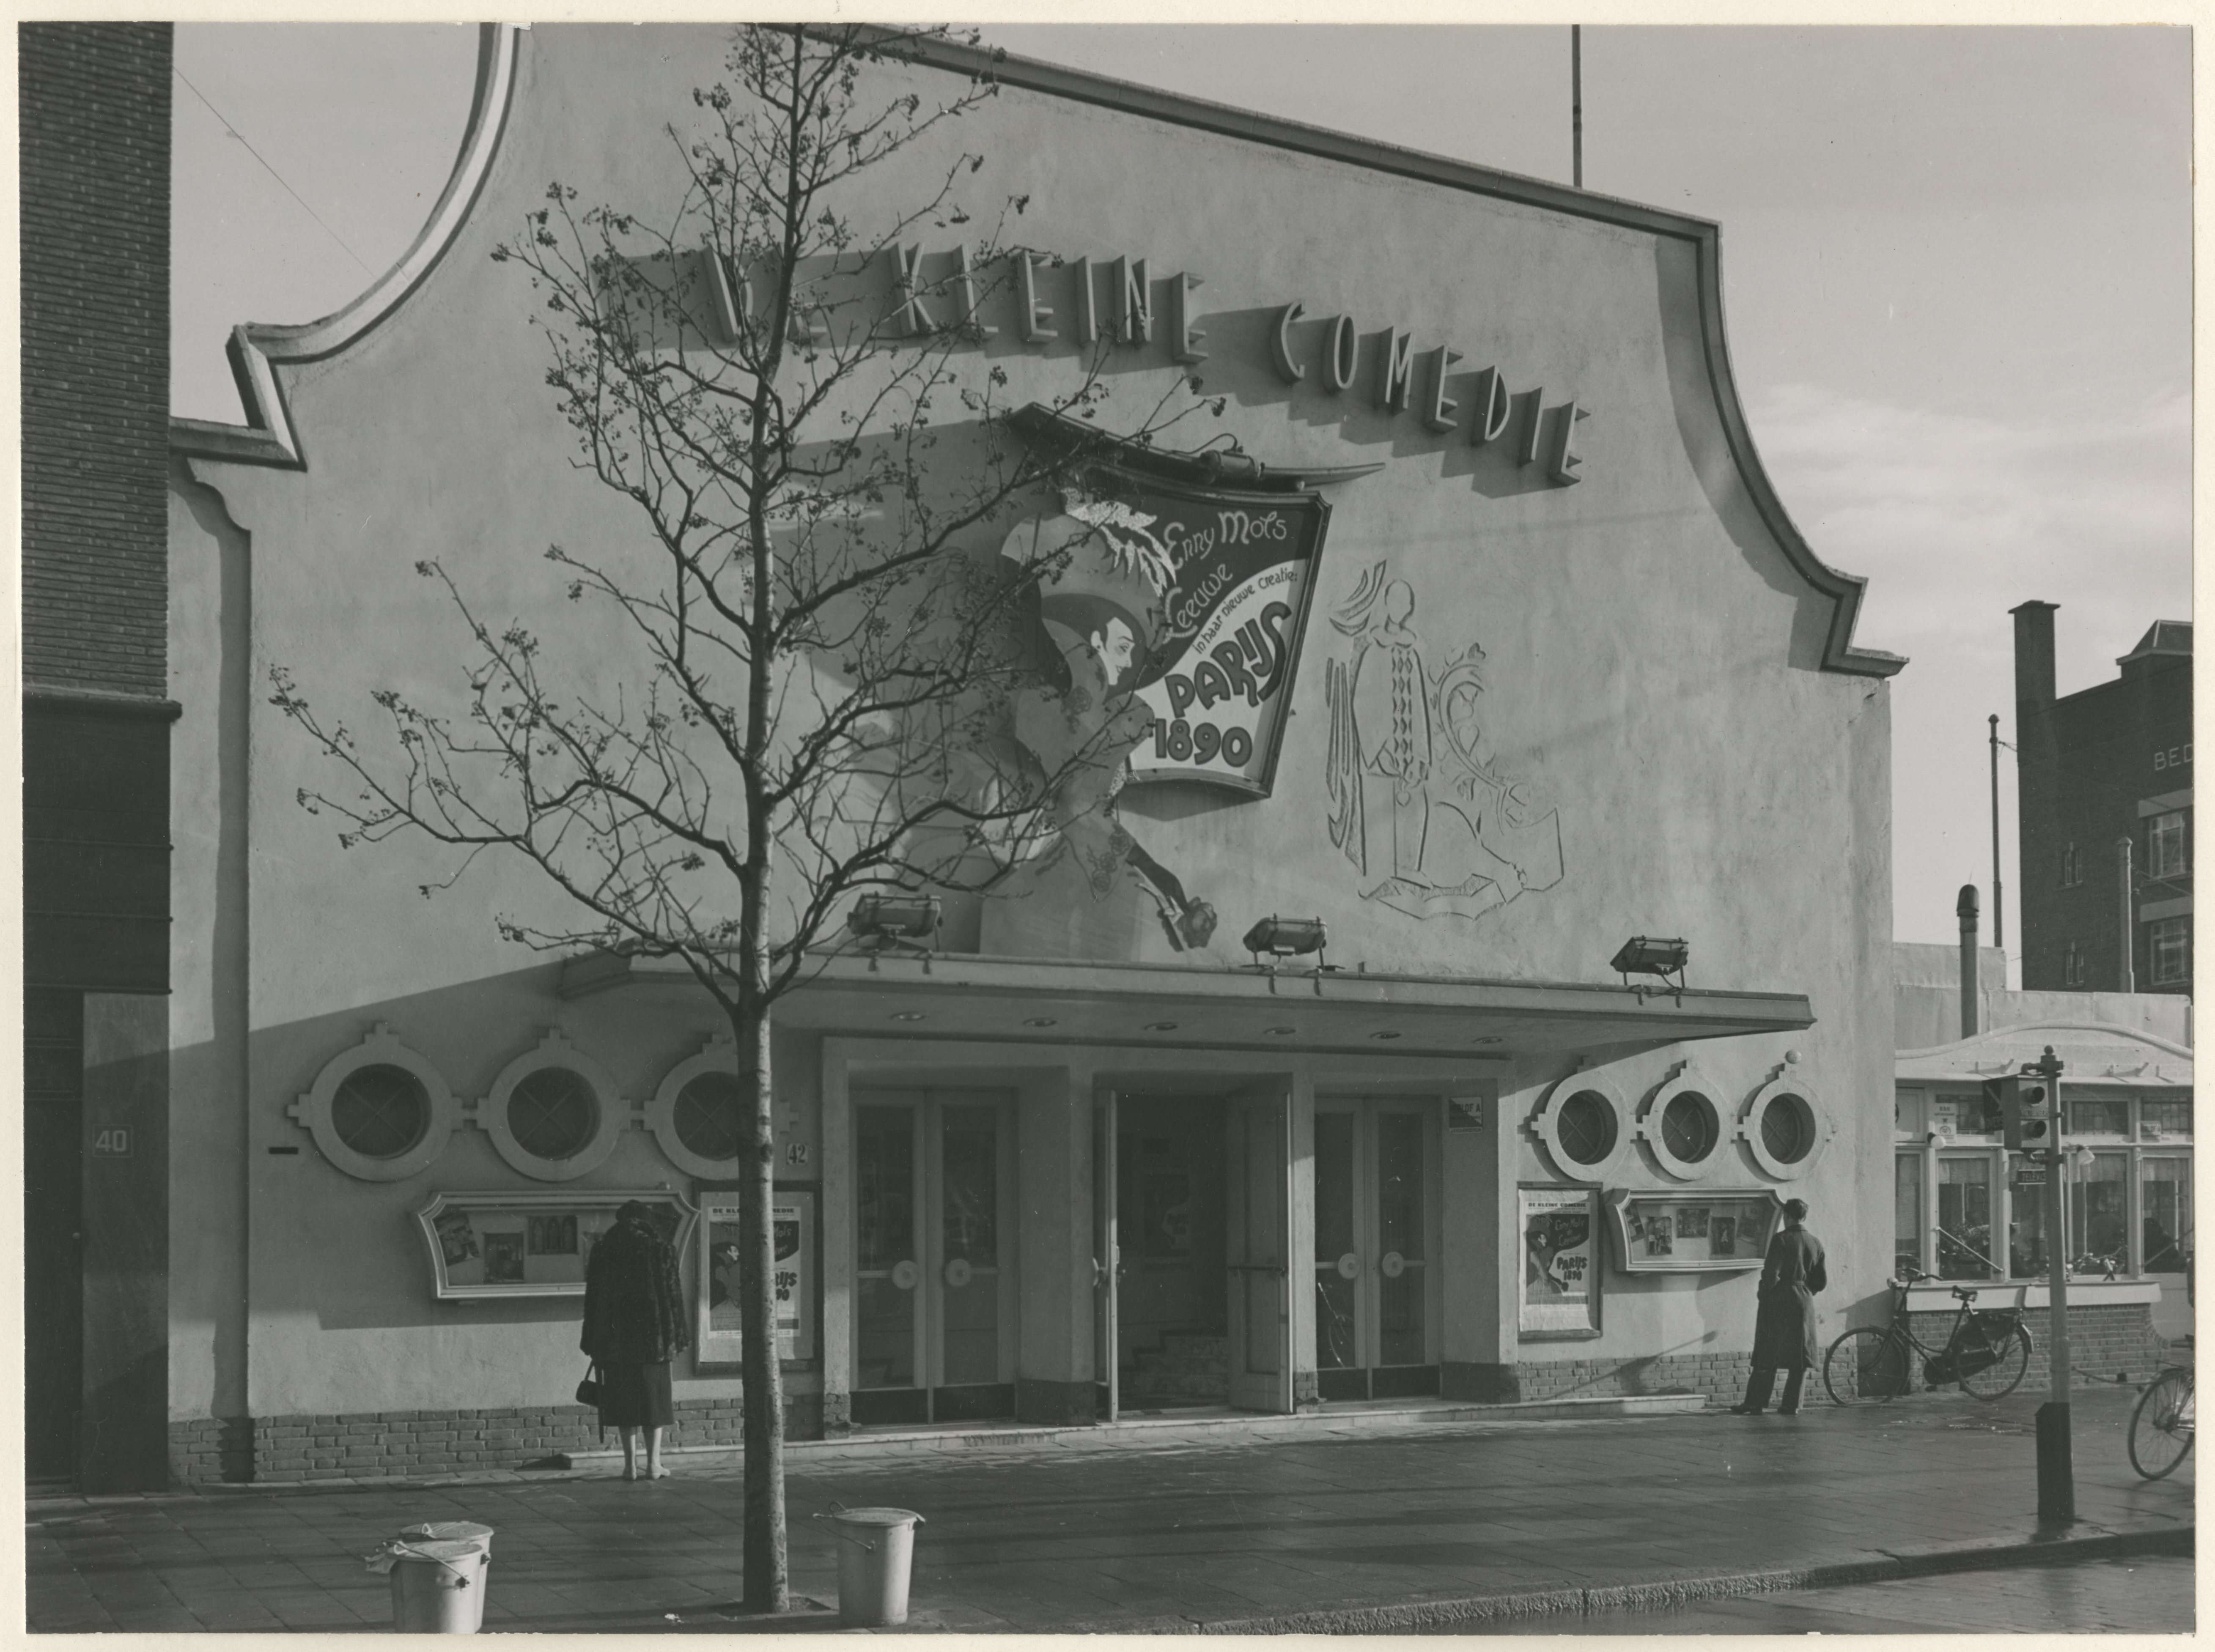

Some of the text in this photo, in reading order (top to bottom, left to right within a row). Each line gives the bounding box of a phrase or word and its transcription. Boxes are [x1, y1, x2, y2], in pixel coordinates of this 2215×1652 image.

[891, 241, 1209, 363] KLEINE
[1278, 299, 1591, 486] COMEDIE
[1164, 521, 1215, 570] Enny
[1163, 564, 1233, 640] Leeuwe
[1192, 644, 1206, 654] in
[1201, 615, 1223, 643] haar
[1221, 584, 1256, 617] nieuwe
[1164, 601, 1292, 719] PARIJS
[1155, 718, 1253, 767] 1890
[2155, 744, 2193, 770] BED
[95, 1130, 126, 1152] 40
[788, 1144, 806, 1164] 42
[1557, 1256, 1588, 1271] PARIJS
[1564, 1270, 1582, 1281] 1890
